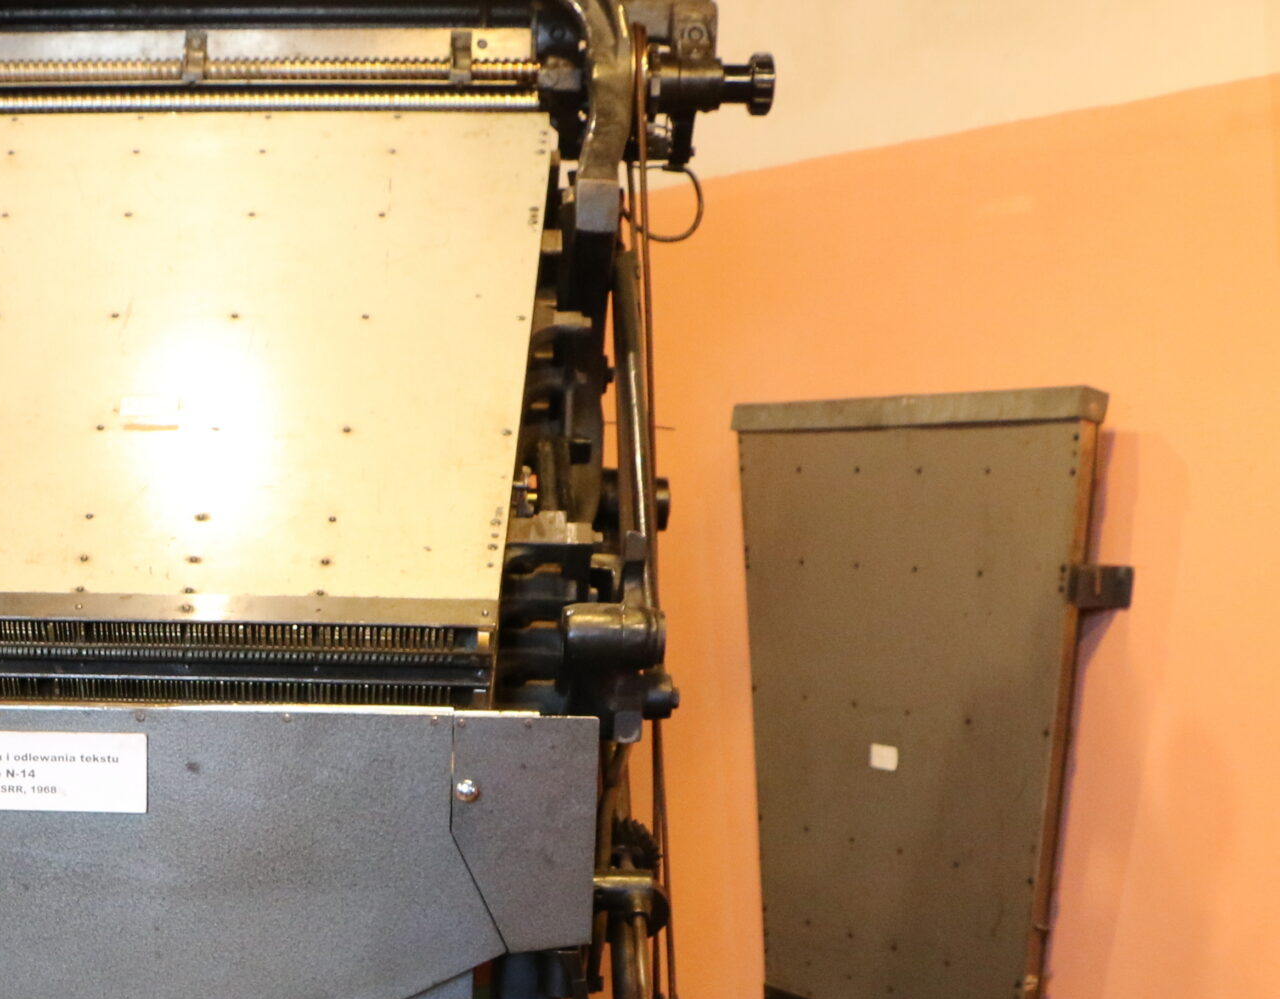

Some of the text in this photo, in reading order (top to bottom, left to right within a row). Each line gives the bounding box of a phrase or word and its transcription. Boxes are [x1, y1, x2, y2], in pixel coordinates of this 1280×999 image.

[14, 752, 76, 762] odlewania
[80, 753, 119, 763] tekstu
[6, 769, 36, 778] N-14
[30, 786, 57, 794] 1968
